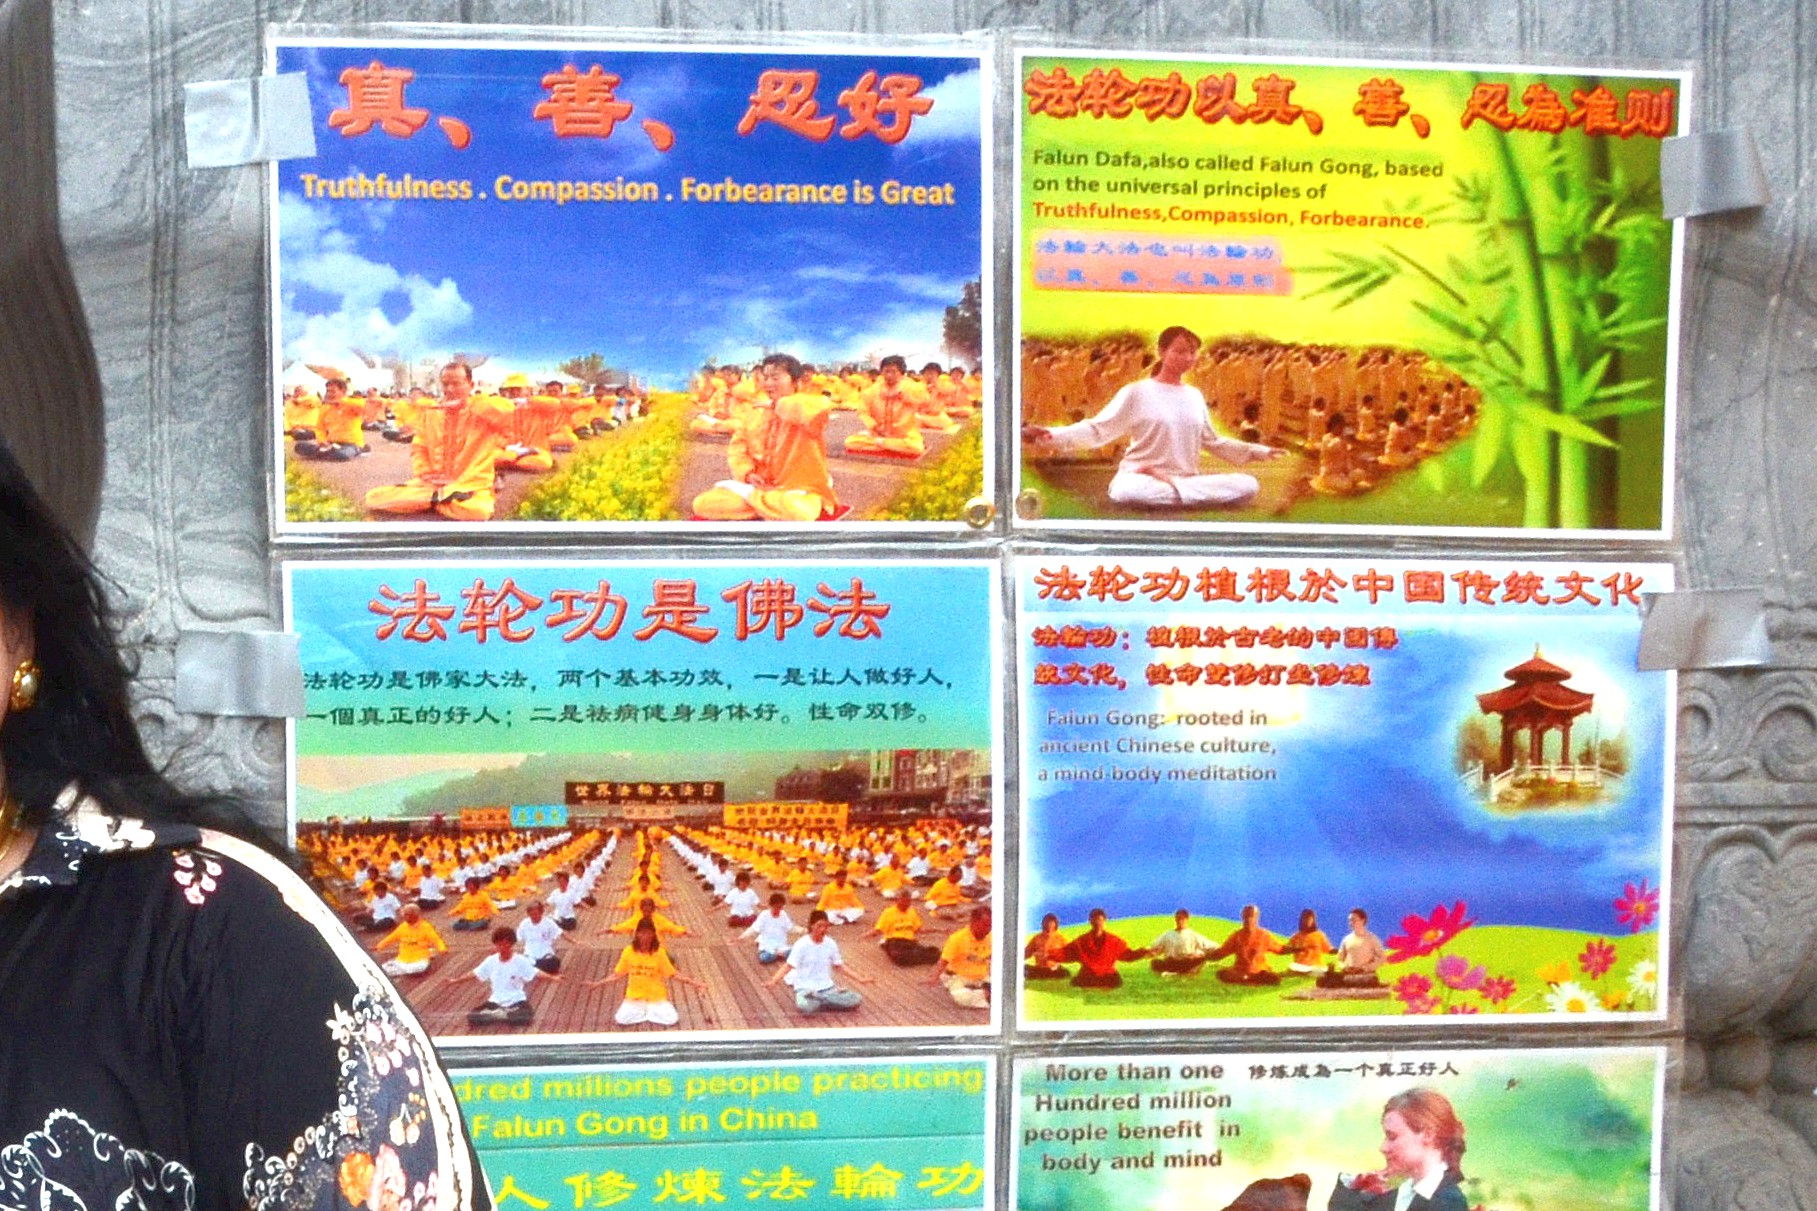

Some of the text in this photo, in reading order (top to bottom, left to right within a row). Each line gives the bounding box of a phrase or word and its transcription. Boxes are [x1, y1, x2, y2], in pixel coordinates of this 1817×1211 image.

[328, 60, 934, 151] 真、善、忍好
[1033, 149, 1088, 166] Falun
[1195, 154, 1253, 172] called
[1260, 157, 1313, 174] Falun
[1320, 158, 1378, 178] Gong,
[1385, 160, 1444, 177] based
[301, 172, 955, 205] Truthfulness Compassion Forbearance is Great
[1033, 176, 1328, 200] on the universal principles of
[368, 577, 891, 643] 法轮功是佛法
[1047, 709, 1267, 730] Falun Gong: rooted in
[1039, 736, 1277, 755] ancient Chinese culture,
[1037, 768, 1048, 781] a
[1167, 764, 1277, 781] meditation
[454, 1063, 984, 1103] dred millions people practicing
[1045, 1063, 1224, 1082] More than one
[1035, 1091, 1232, 1112] Hundred million
[472, 1106, 819, 1139] Falun Gong in China
[1024, 1119, 1241, 1146] people benefit in
[1042, 1148, 1222, 1175] body and mind
